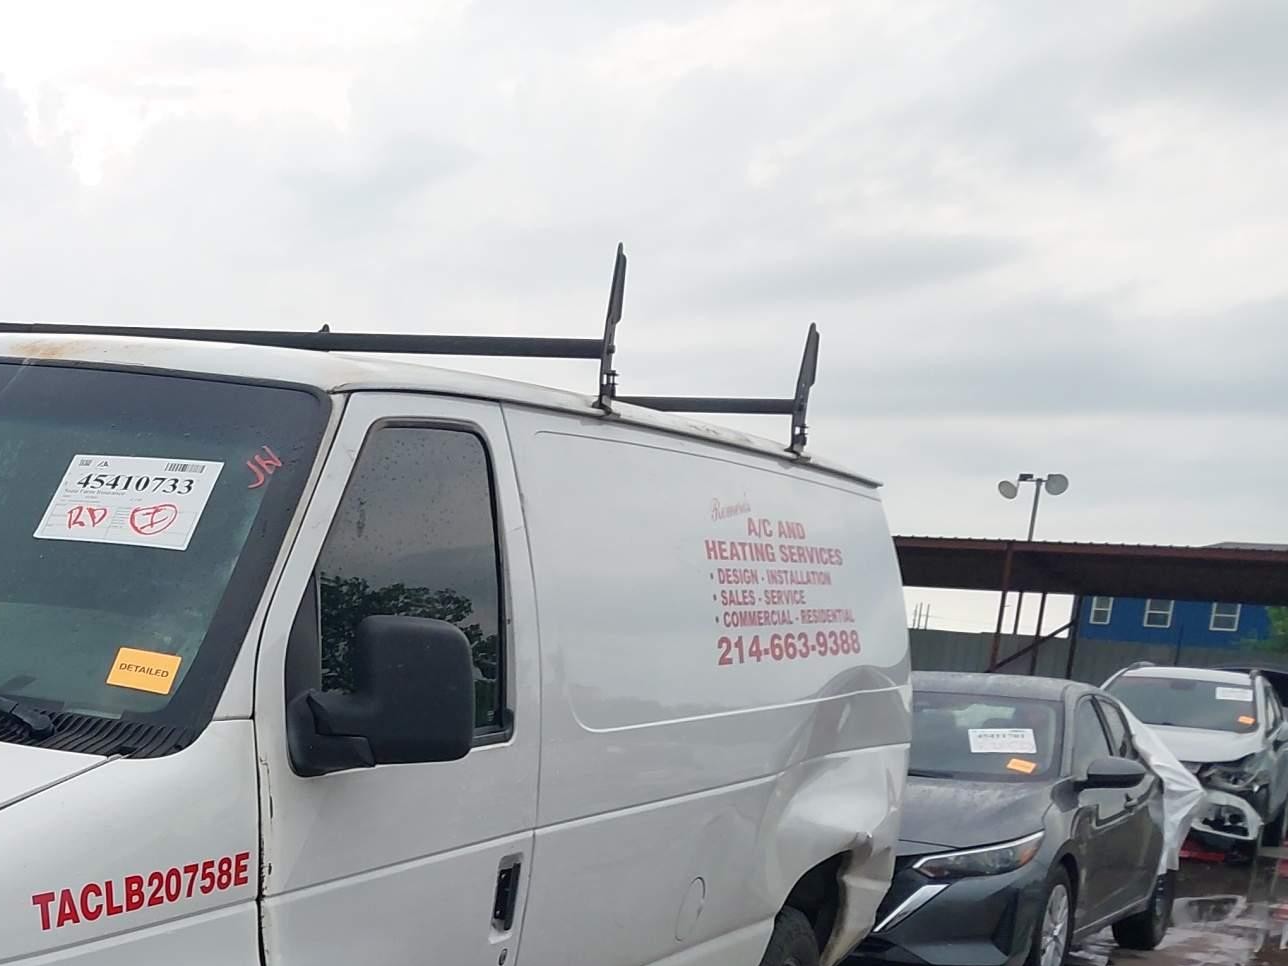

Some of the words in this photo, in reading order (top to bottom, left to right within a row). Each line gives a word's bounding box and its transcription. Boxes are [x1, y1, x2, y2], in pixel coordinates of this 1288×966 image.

[76, 473, 195, 495] 45410733
[747, 517, 774, 538] A/C
[777, 521, 806, 540] AND
[705, 540, 776, 563] HEATING
[779, 544, 843, 566] SERVICES
[718, 568, 759, 585] DESIGN
[766, 570, 832, 585] INSTALLATION
[721, 590, 756, 606] SALES
[763, 589, 806, 605] SERVICE
[723, 610, 793, 627] COMMERCIAL
[800, 609, 855, 624] RESIDENTIAL
[717, 629, 862, 666] 214-663-9388
[119, 662, 169, 678] DETAILED
[31, 851, 251, 931] TACLB20758E
